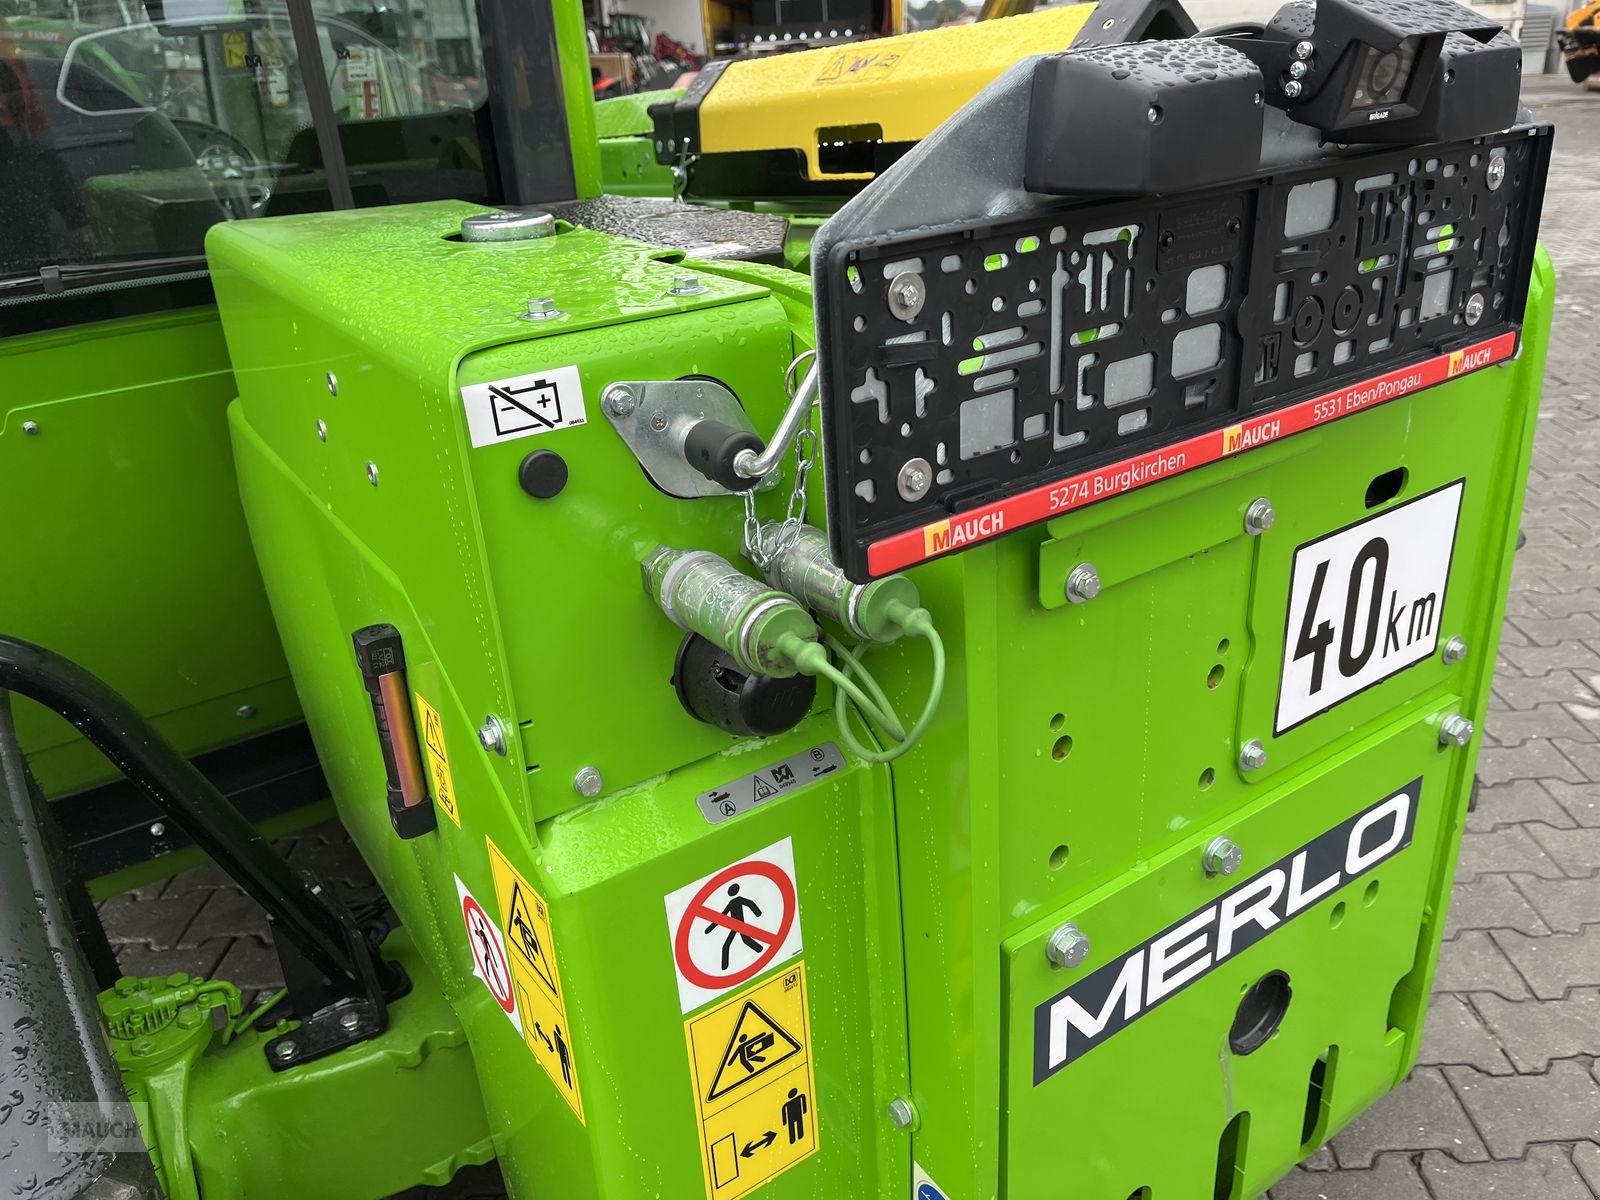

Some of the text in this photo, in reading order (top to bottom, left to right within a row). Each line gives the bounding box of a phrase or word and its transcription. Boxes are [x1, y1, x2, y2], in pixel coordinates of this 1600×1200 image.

[1368, 111, 1389, 121] BRIGADE
[932, 347, 1492, 552] MAUCH 5274 Burgkirchen MAUCH 5531 Eben/Pongau MAUCH
[1048, 792, 1411, 1071] MERLO
